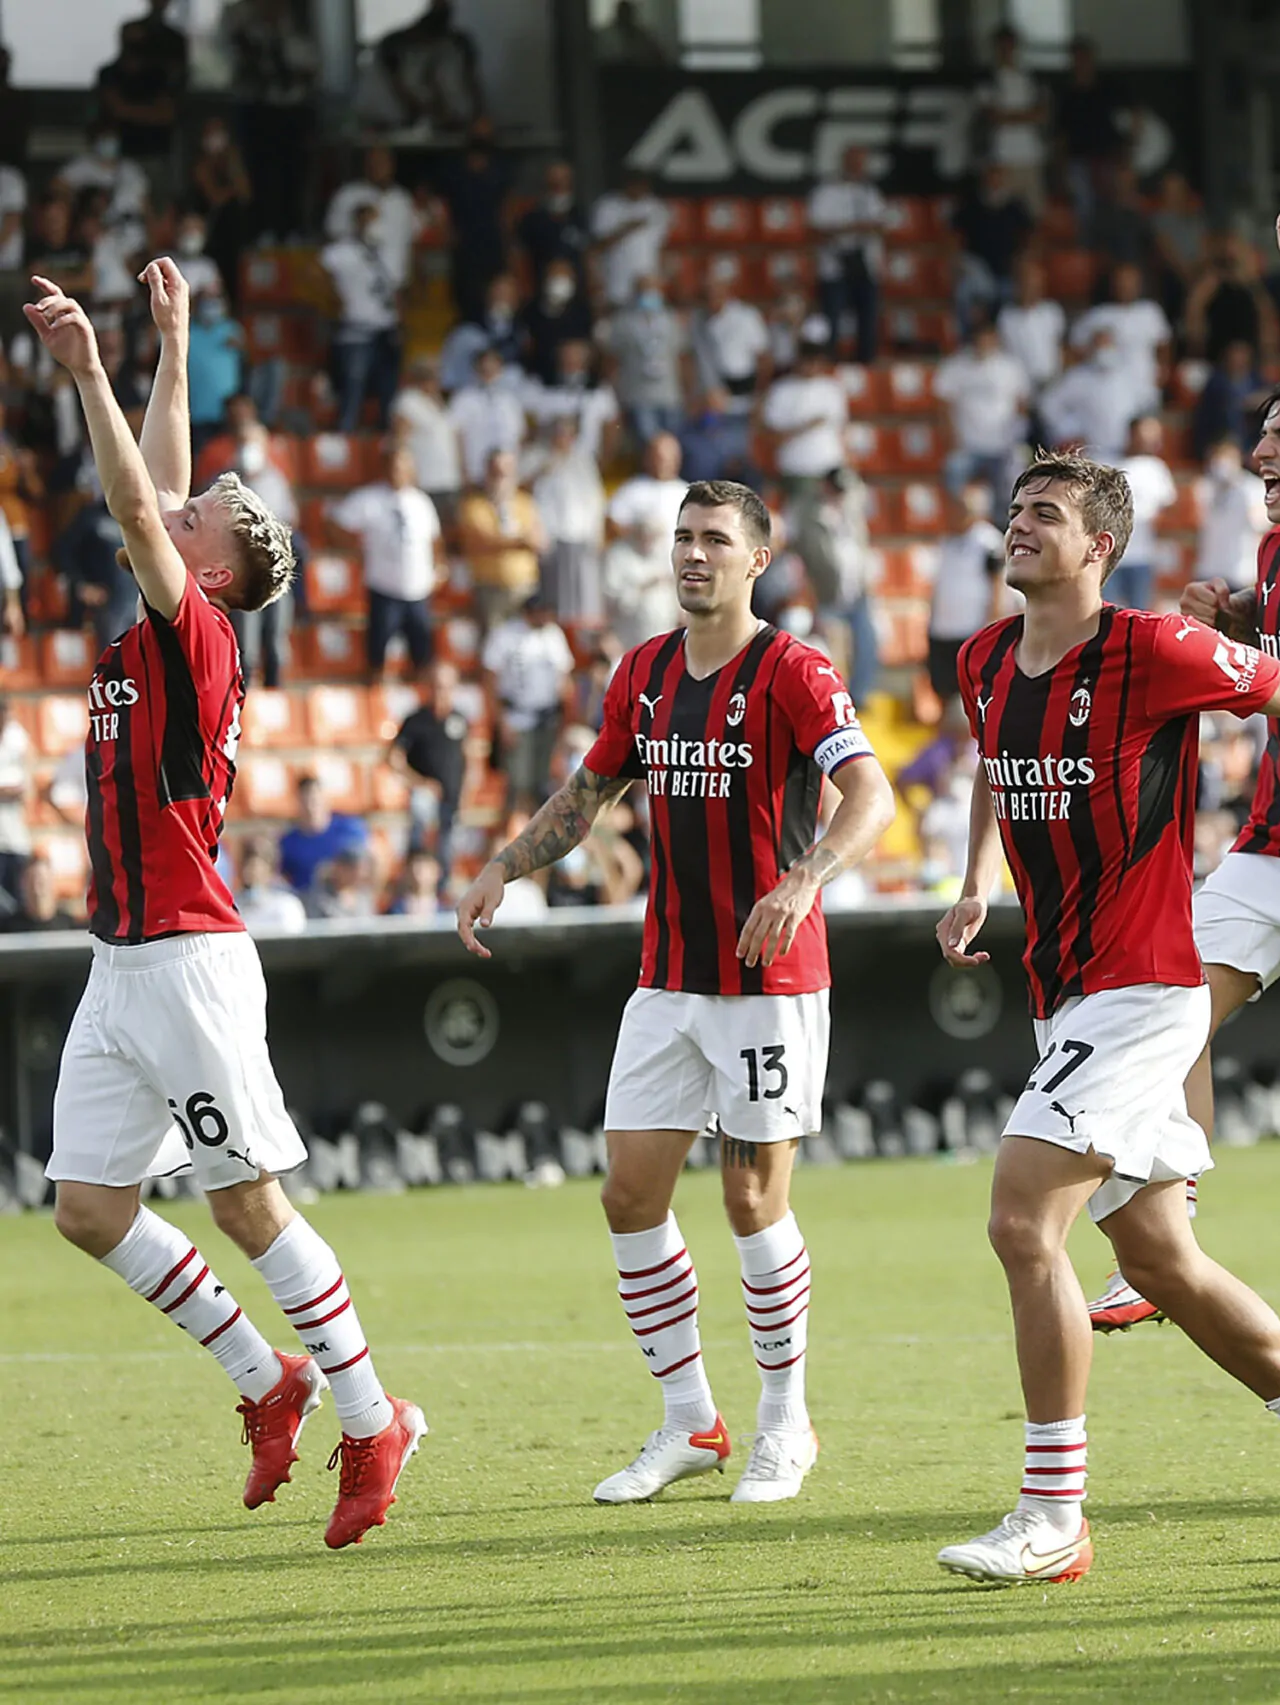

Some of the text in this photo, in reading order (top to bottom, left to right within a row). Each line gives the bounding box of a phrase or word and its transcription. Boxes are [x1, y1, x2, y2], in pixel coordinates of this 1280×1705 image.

[634, 733, 753, 768] Emirates
[980, 750, 1096, 786] mirates
[648, 771, 731, 798] FLY BETTER
[1010, 791, 1071, 820] BETTER
[740, 1044, 788, 1102] 13
